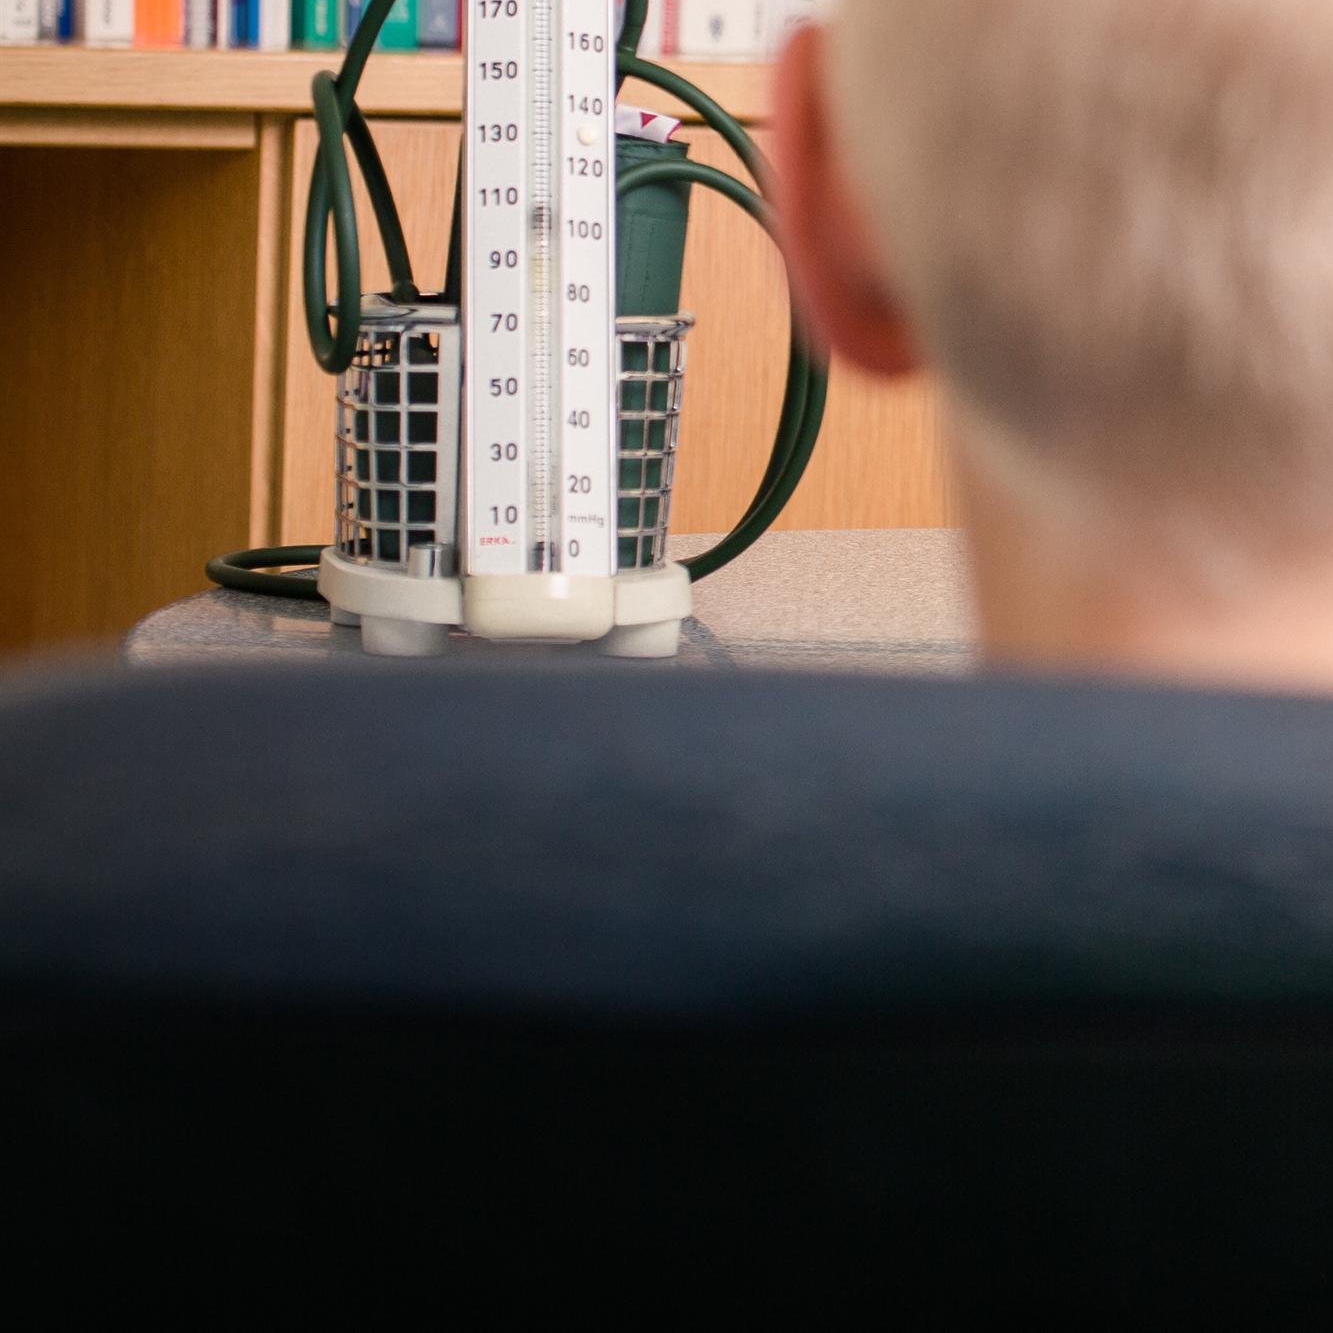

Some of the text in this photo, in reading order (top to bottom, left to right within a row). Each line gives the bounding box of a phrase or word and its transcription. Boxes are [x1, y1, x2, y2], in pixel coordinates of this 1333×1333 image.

[567, 31, 604, 54] 160
[479, 60, 518, 81] 150
[567, 94, 603, 117] 140
[478, 122, 519, 144] 130
[567, 156, 604, 179] 120
[478, 186, 519, 208] 110
[567, 218, 603, 241] 100
[488, 249, 518, 270] 90
[566, 282, 591, 304] 80
[489, 312, 519, 334] 70
[567, 347, 590, 368] 60
[489, 376, 519, 398] 50
[567, 409, 591, 430] 40
[489, 442, 518, 463] 30
[567, 474, 592, 495] 20
[489, 504, 518, 526] 10
[568, 538, 580, 558] 0
